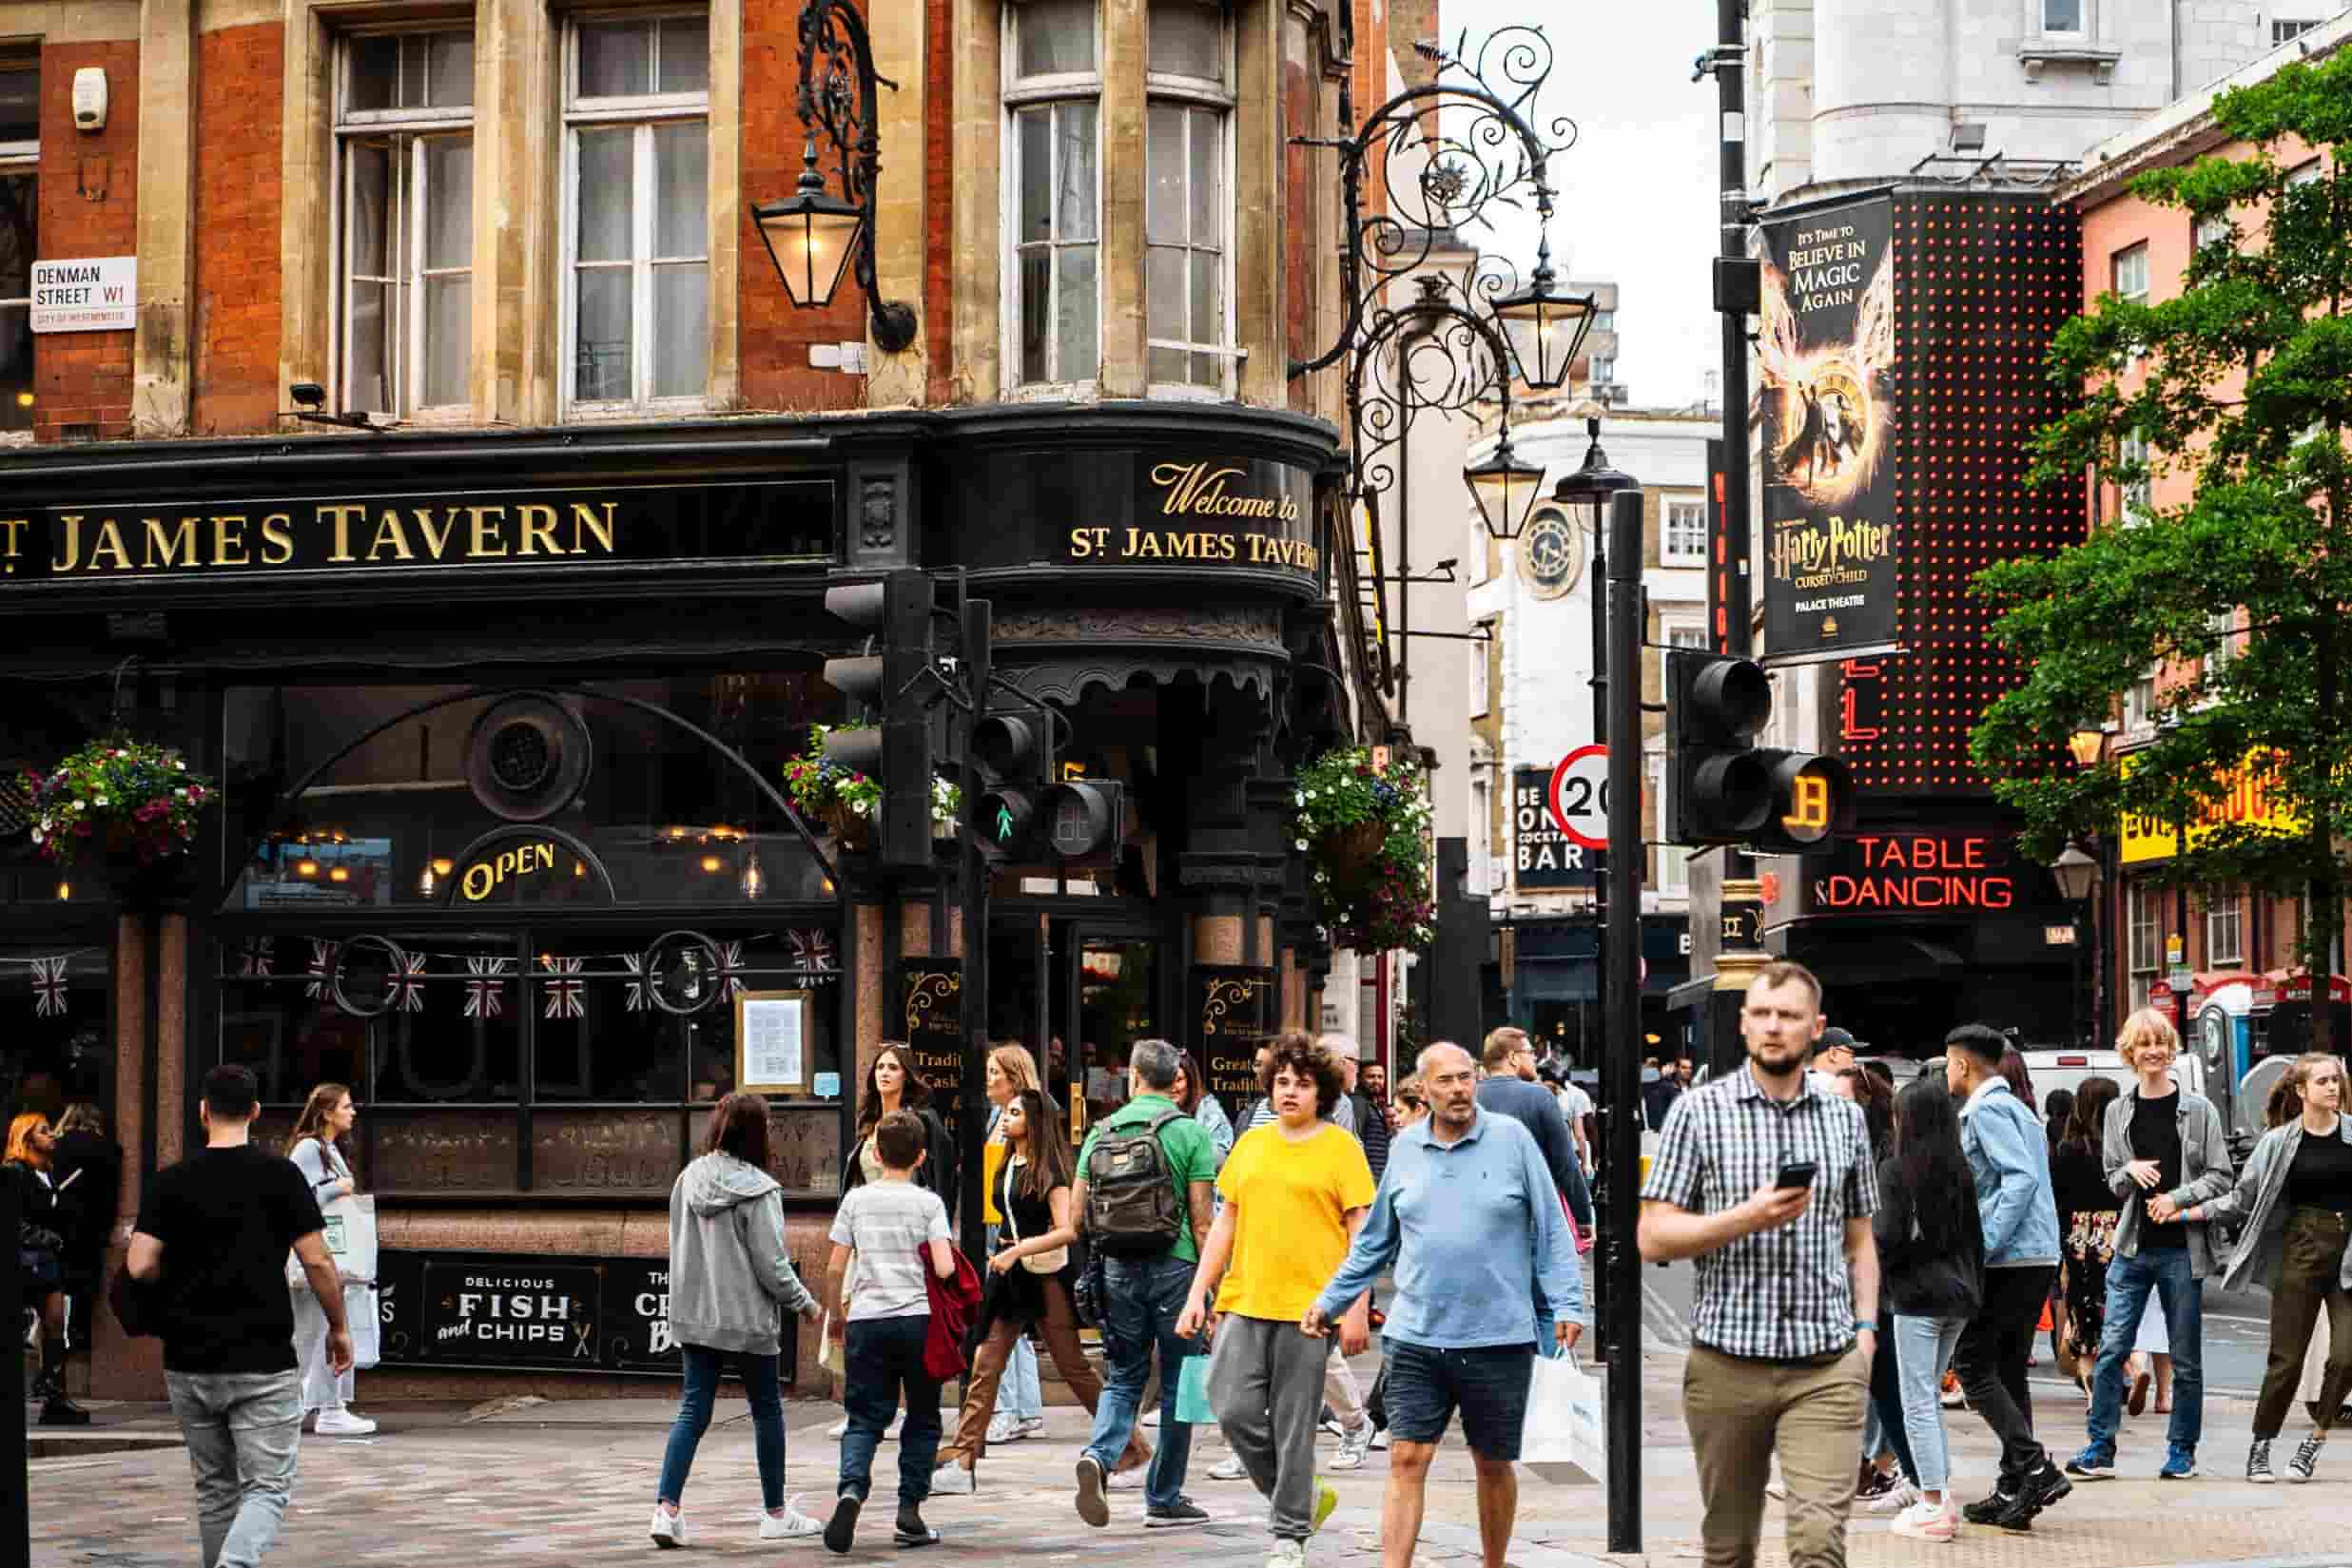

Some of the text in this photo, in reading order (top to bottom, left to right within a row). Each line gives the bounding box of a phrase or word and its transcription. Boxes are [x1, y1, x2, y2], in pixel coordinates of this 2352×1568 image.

[1841, 224, 1855, 237] TO
[1788, 239, 1866, 271] BELIEVE IN
[38, 265, 100, 284] DENMAN
[1794, 262, 1860, 295] MAGIC
[38, 285, 123, 304] STREET W1
[1801, 288, 1854, 313] AGAIN
[1151, 461, 1297, 520] Welcome to
[52, 514, 293, 571] JAMES
[317, 502, 619, 562] TAVERN
[1122, 528, 1235, 559] JAMES
[1828, 515, 1892, 567] Potter
[1795, 594, 1865, 612] PALACE THEATRE
[1518, 786, 1540, 807] BE
[1518, 844, 1584, 871] BAR
[1856, 838, 1986, 869] TABLE
[465, 1277, 554, 1289] DELICIOUS
[457, 1293, 571, 1320] FISH
[437, 1318, 564, 1343] and CHIPS
